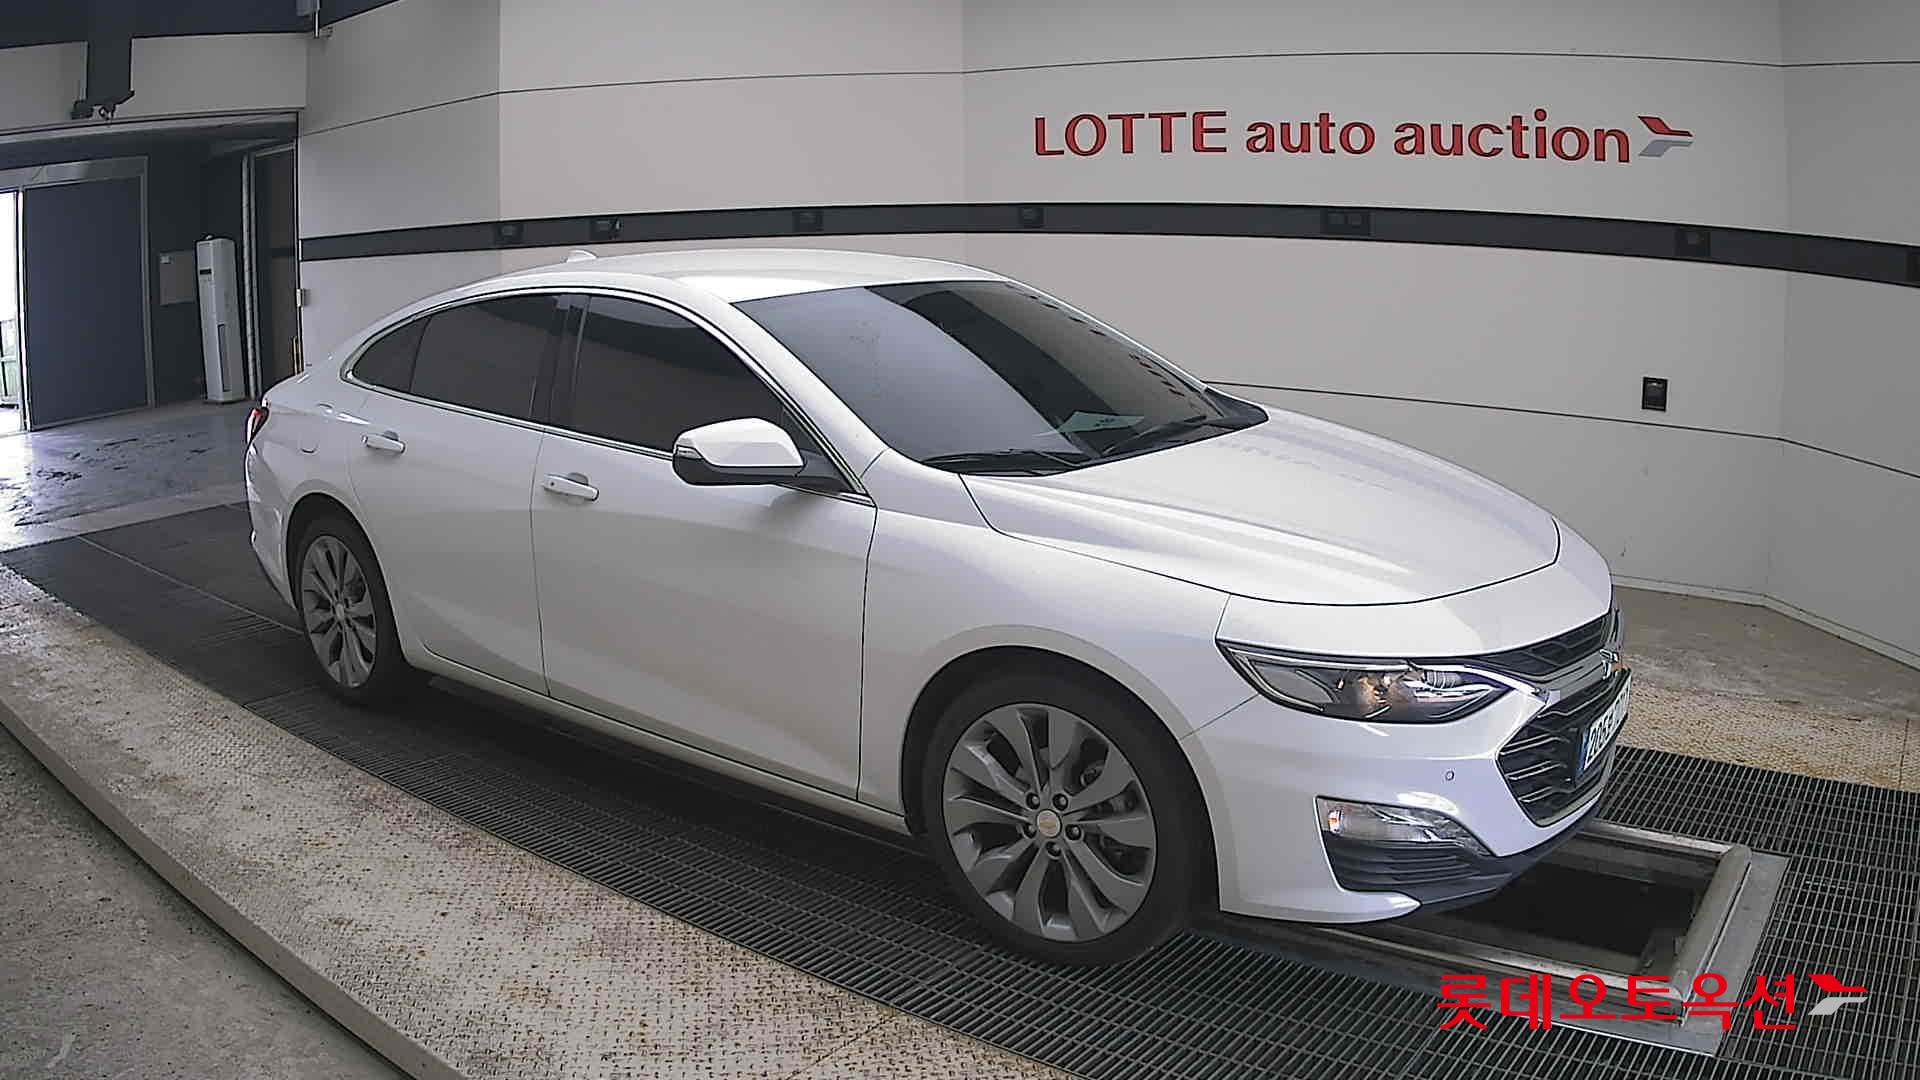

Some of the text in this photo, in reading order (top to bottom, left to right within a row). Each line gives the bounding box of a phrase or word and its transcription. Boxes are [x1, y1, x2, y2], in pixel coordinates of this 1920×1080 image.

[1035, 108, 1630, 163] LOTTE auto auction
